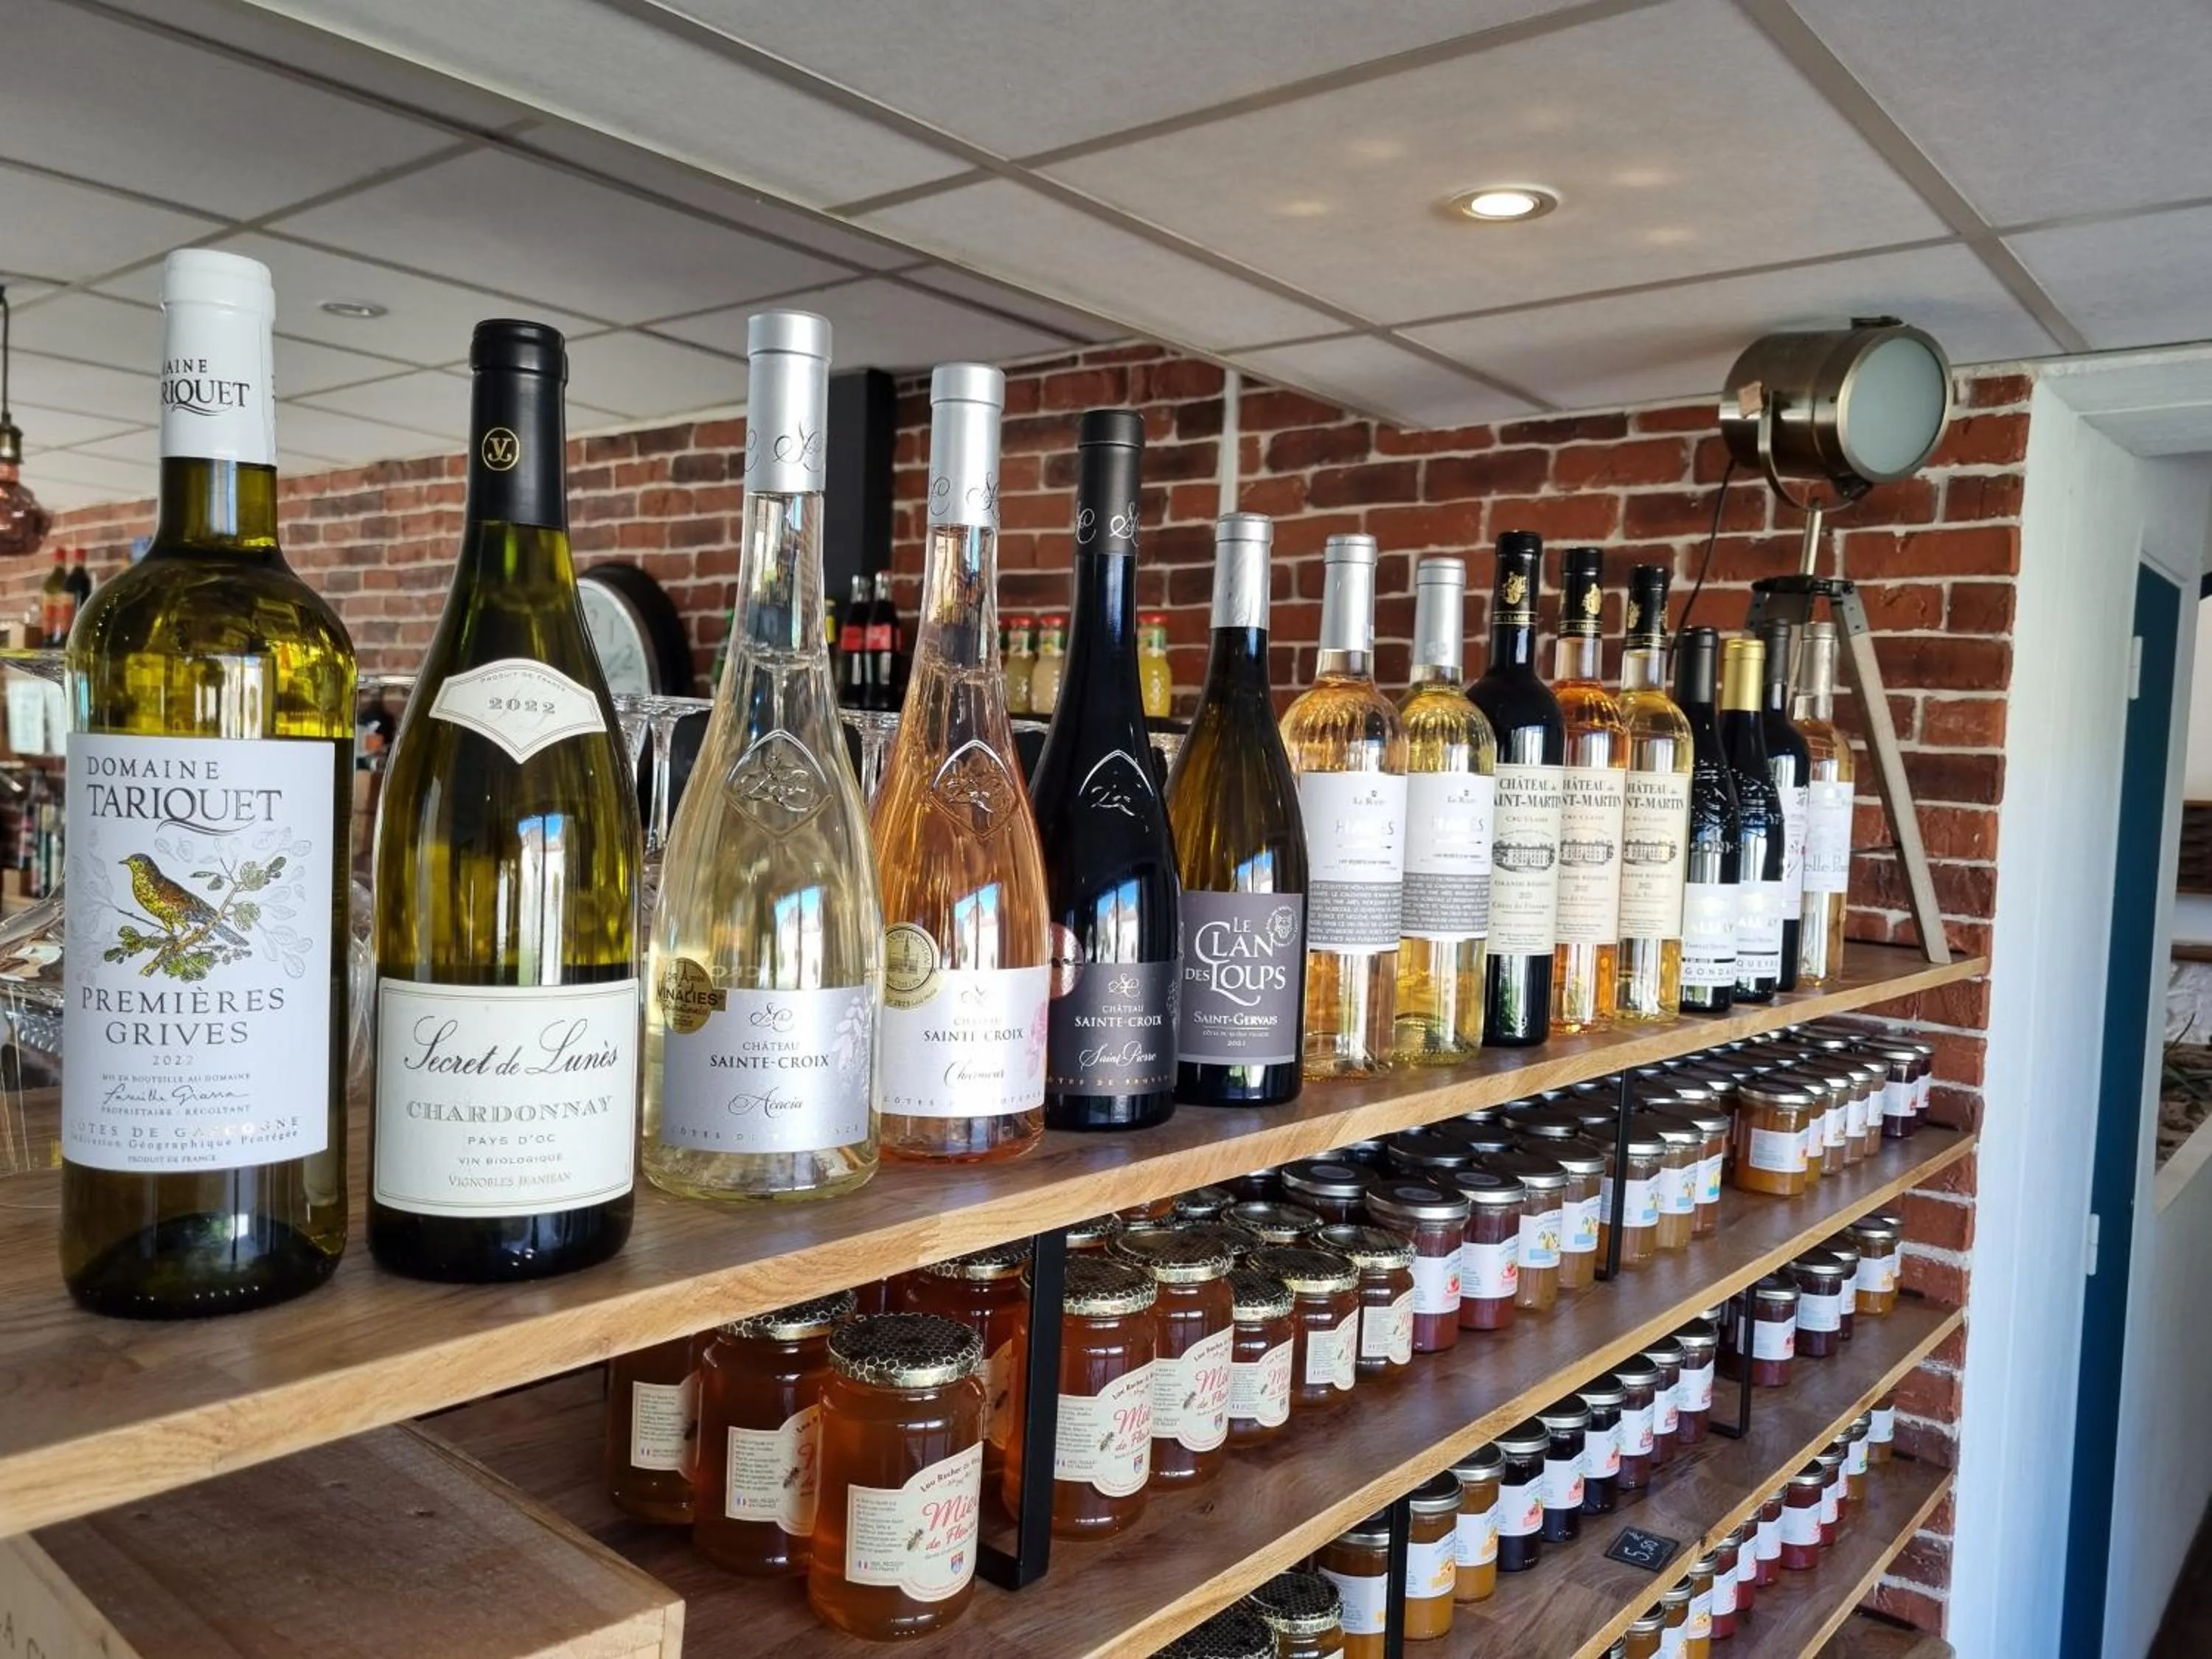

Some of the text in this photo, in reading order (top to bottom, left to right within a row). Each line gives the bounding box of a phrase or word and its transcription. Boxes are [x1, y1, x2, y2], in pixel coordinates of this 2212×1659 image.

[489, 697, 556, 714] 2022
[86, 756, 220, 779] DOMAINE
[86, 784, 282, 836] TARIQUET
[1233, 916, 1252, 933] LE
[1194, 921, 1275, 964] CLAN
[1185, 961, 1287, 1006] DES LOUPS
[81, 985, 285, 1015] PREMIÈRES
[1194, 1011, 1278, 1026] SAINT-GERVAIS
[105, 1020, 249, 1046] GRIVES
[404, 1015, 498, 1075] Secret
[495, 1045, 522, 1076] de
[709, 1054, 830, 1069] SAINTE-CROIX
[406, 1095, 613, 1123] CHARDONNAY
[131, 1127, 159, 1138] DE
[467, 1133, 556, 1146] PAYS D'OC
[459, 1152, 563, 1166] VIN BIOLOGIQUE
